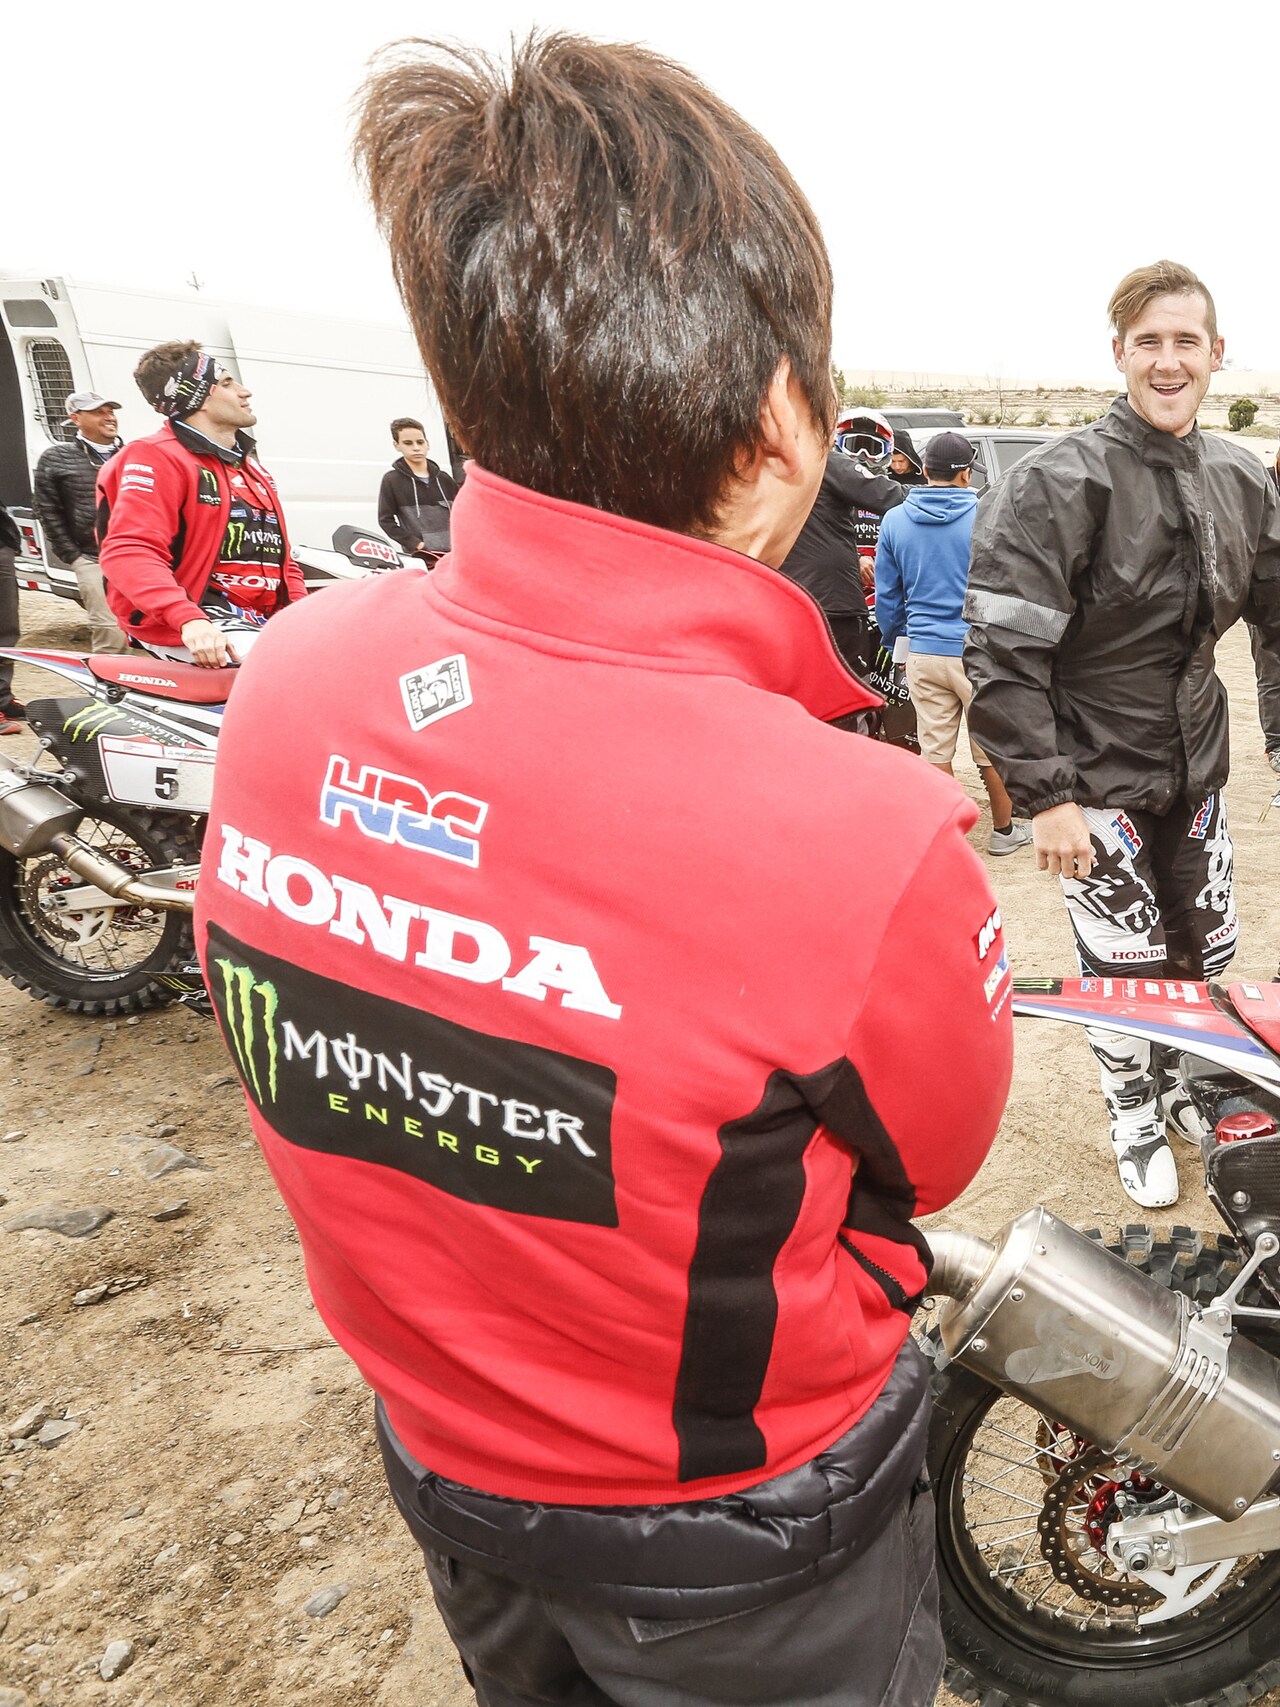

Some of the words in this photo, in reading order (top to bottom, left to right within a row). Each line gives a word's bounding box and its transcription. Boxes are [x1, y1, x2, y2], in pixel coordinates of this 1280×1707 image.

[212, 573, 281, 591] HON
[118, 673, 178, 688] HONDA
[869, 671, 911, 700] ONSTE
[154, 766, 180, 801] 5
[319, 754, 488, 869] HRC
[216, 823, 623, 1020] HONDA
[1208, 914, 1238, 945] HON
[1111, 949, 1167, 961] HONDA
[282, 1021, 596, 1158] MONSTER
[328, 1094, 543, 1173] ENERGY
